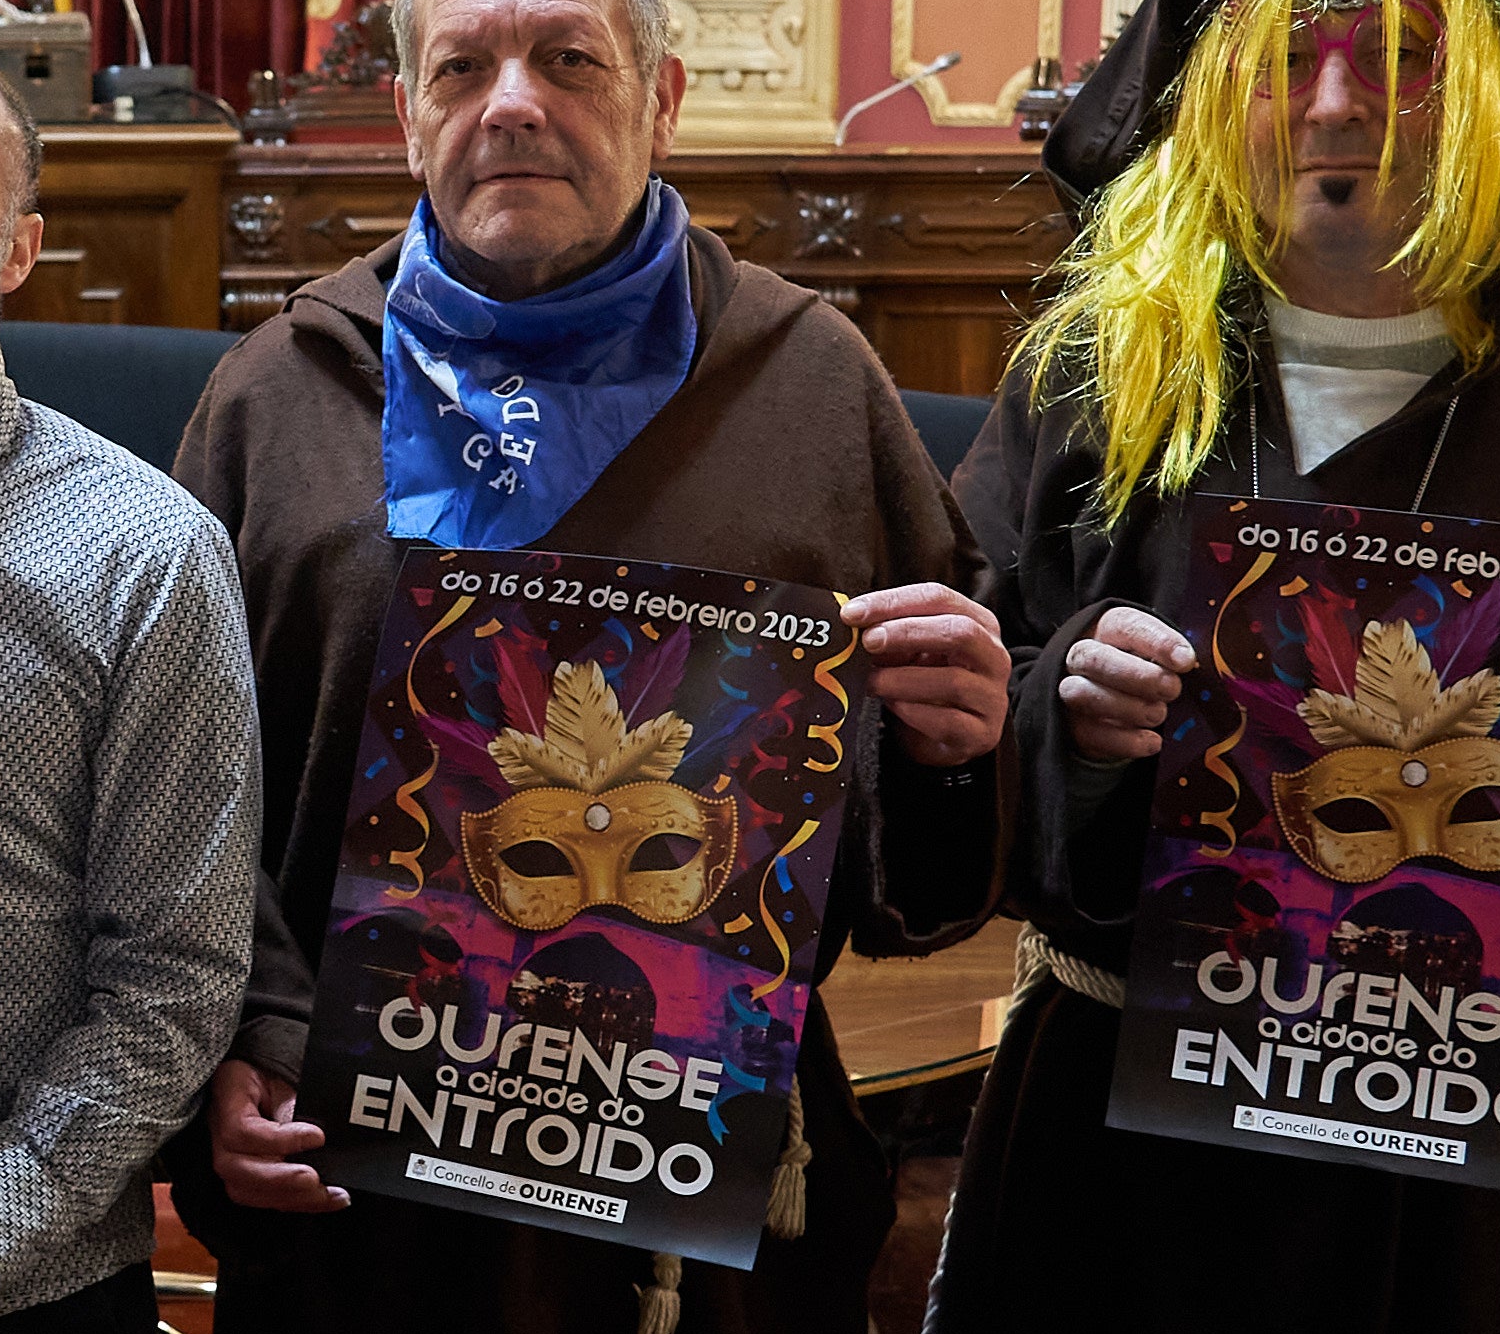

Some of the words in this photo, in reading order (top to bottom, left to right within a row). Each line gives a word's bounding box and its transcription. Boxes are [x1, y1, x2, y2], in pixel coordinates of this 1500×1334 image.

[1238, 523, 1280, 548] do
[1286, 527, 1319, 553] 16
[1352, 535, 1387, 563] 22
[1394, 541, 1438, 569] de
[441, 569, 482, 593] do
[488, 573, 518, 597] 16
[549, 579, 583, 606] 22
[588, 584, 629, 613] de
[634, 591, 757, 634] febreiro
[759, 611, 830, 647] 2023
[379, 996, 723, 1112] OURENSE
[1258, 1016, 1281, 1039] a
[1291, 1020, 1418, 1059] cidade
[1428, 1038, 1476, 1069] do
[435, 1064, 459, 1087] a
[468, 1069, 589, 1114] cidade
[598, 1096, 644, 1126] do
[349, 1074, 714, 1196] ENTROIDO
[1262, 1115, 1327, 1138] Concello
[1332, 1126, 1349, 1141] de
[1353, 1129, 1458, 1159] OURENSE
[433, 1164, 495, 1191] Concello
[498, 1180, 517, 1196] de
[519, 1184, 620, 1218] OURENSE
